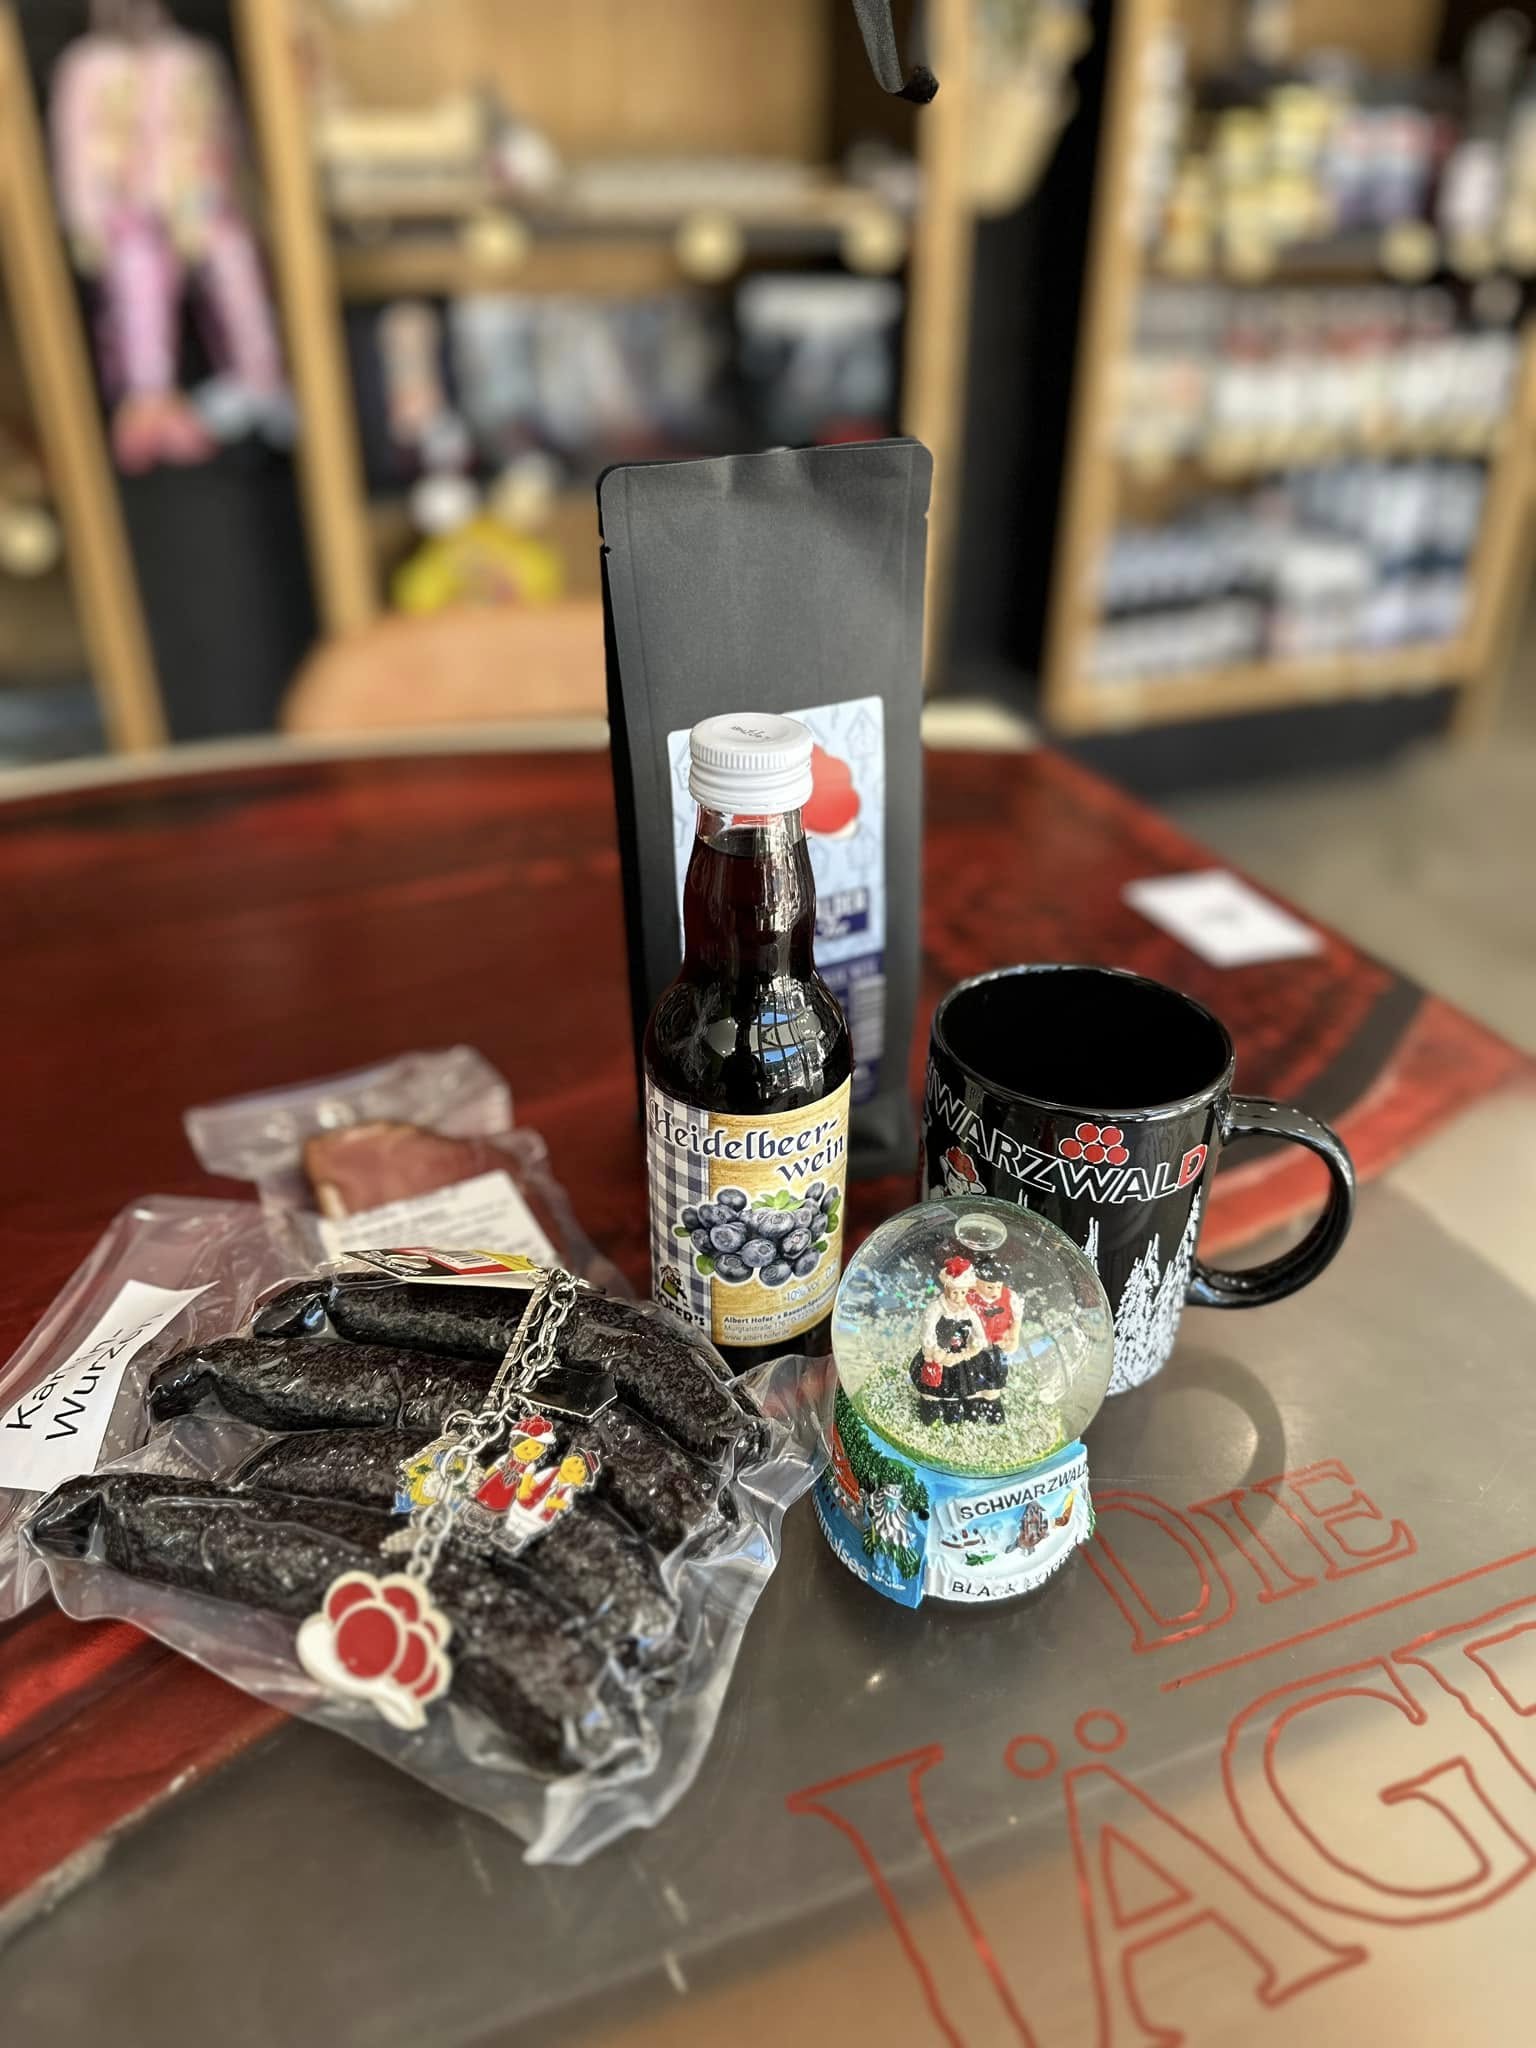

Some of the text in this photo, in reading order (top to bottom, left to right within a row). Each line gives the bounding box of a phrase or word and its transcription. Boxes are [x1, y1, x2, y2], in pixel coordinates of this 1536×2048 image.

[649, 1099, 839, 1159] Heidelbeer-
[776, 1135, 844, 1181] wein
[723, 1315, 749, 1325] Albert
[1079, 1458, 1418, 1655] DIE
